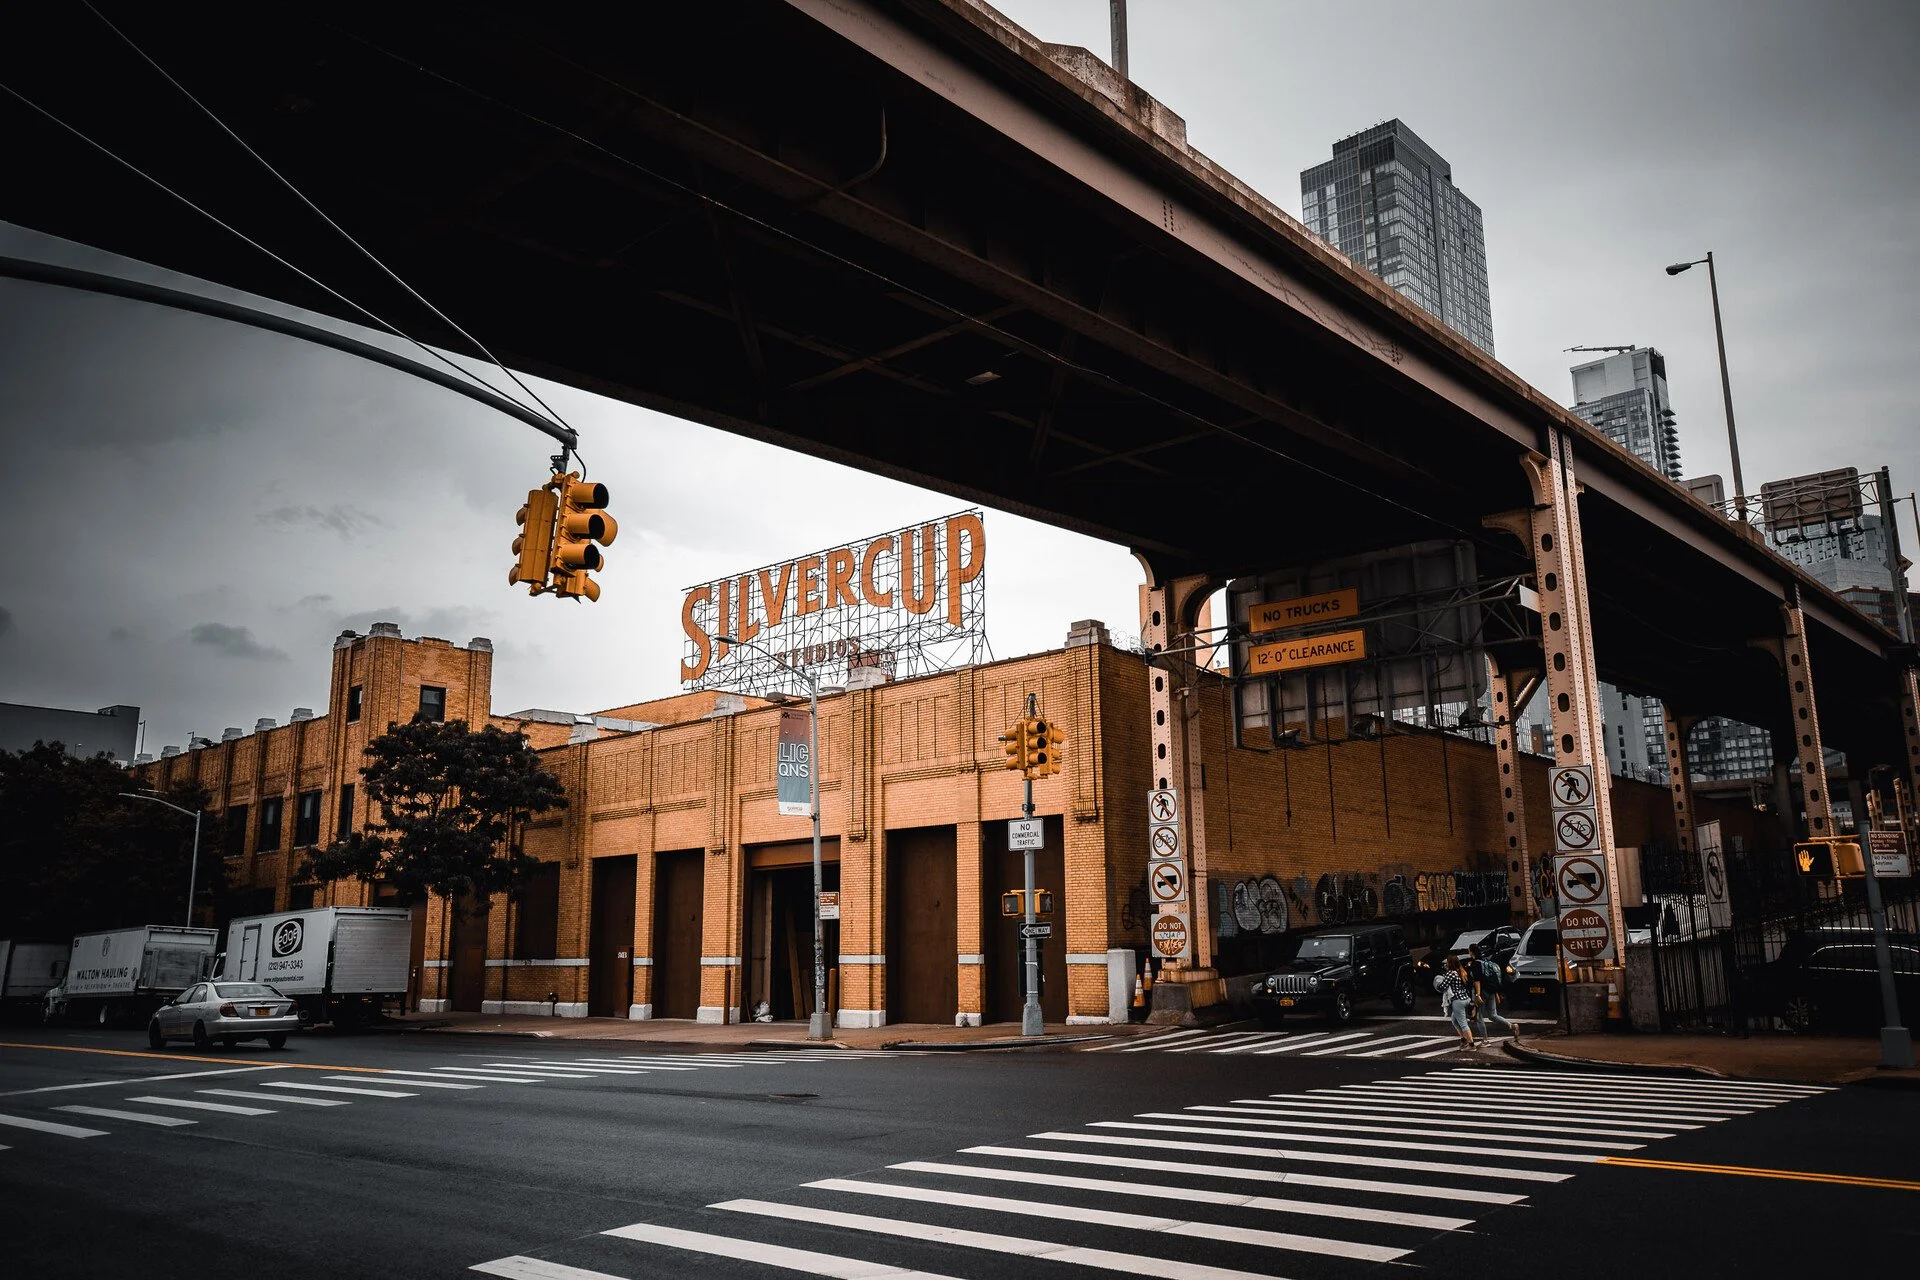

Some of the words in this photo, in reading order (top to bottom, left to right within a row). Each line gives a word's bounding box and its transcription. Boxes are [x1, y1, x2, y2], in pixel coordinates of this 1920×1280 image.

[681, 513, 986, 685] SILVERCUP
[1263, 610, 1281, 623] NO
[1286, 600, 1341, 619] TRUCKS
[776, 636, 861, 671] STUDIOS
[1289, 640, 1356, 661] CLEARANCE
[778, 742, 809, 764] LIC
[778, 763, 809, 778] QNS
[1020, 823, 1031, 831] NO
[1012, 831, 1040, 839] COMMERCIAL
[1017, 838, 1035, 846] TRAFFIC
[1158, 922, 1168, 930] DO
[1169, 922, 1182, 930] NOT
[1566, 917, 1579, 927] DO
[1582, 916, 1599, 926] NOT
[1024, 927, 1036, 935] ONE
[278, 928, 298, 948] edge
[1570, 939, 1604, 950] ENTER
[77, 969, 100, 980] WALTON
[101, 967, 128, 979] HAULING
